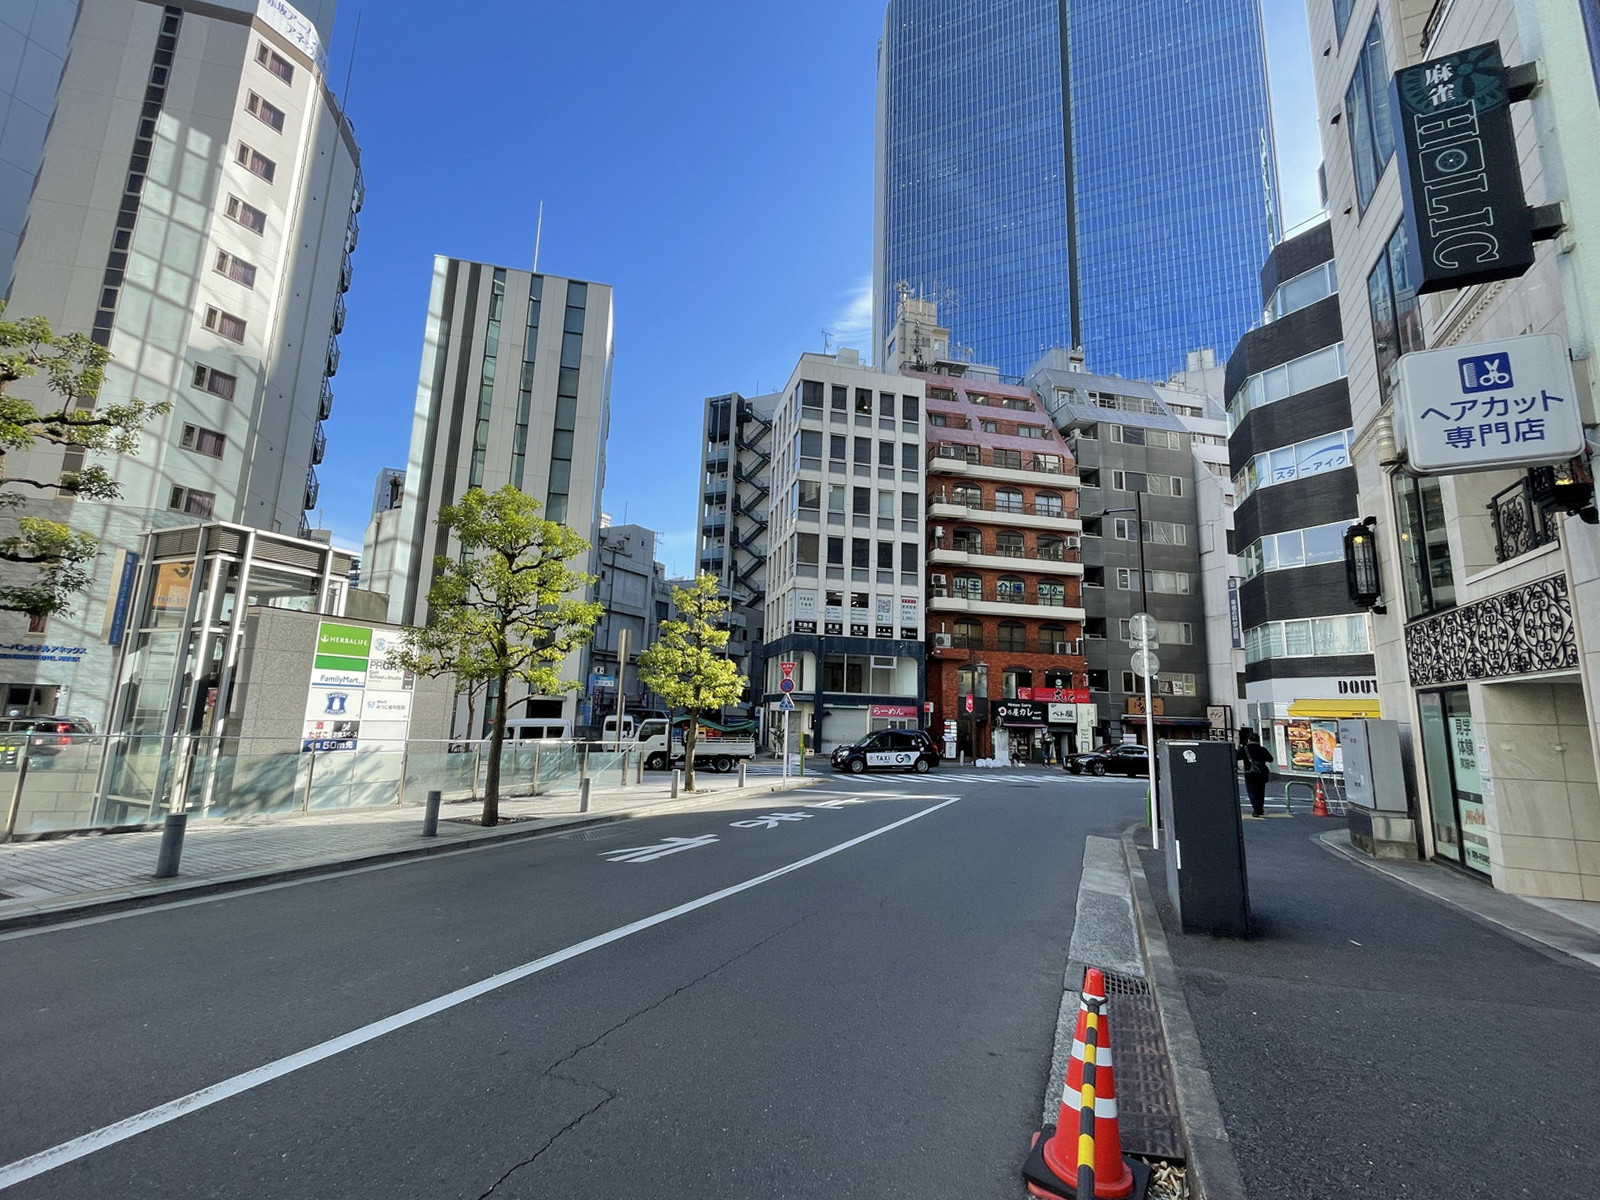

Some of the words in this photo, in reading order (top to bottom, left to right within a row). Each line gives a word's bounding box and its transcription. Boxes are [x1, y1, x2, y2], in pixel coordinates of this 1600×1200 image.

[1425, 62, 1456, 107] 麻雀
[1414, 99, 1500, 269] HOLIC
[1420, 389, 1564, 422] ヘアカット
[1443, 418, 1546, 449] 専門店
[1276, 456, 1346, 480] スターアイク
[330, 636, 368, 646] HERBALIFE
[320, 674, 359, 685] FamilyMart
[873, 706, 904, 716] らーめん
[308, 731, 330, 740] たばこ
[1455, 718, 1471, 736] 見学
[1457, 738, 1475, 757] 体験
[895, 753, 911, 764] GO
